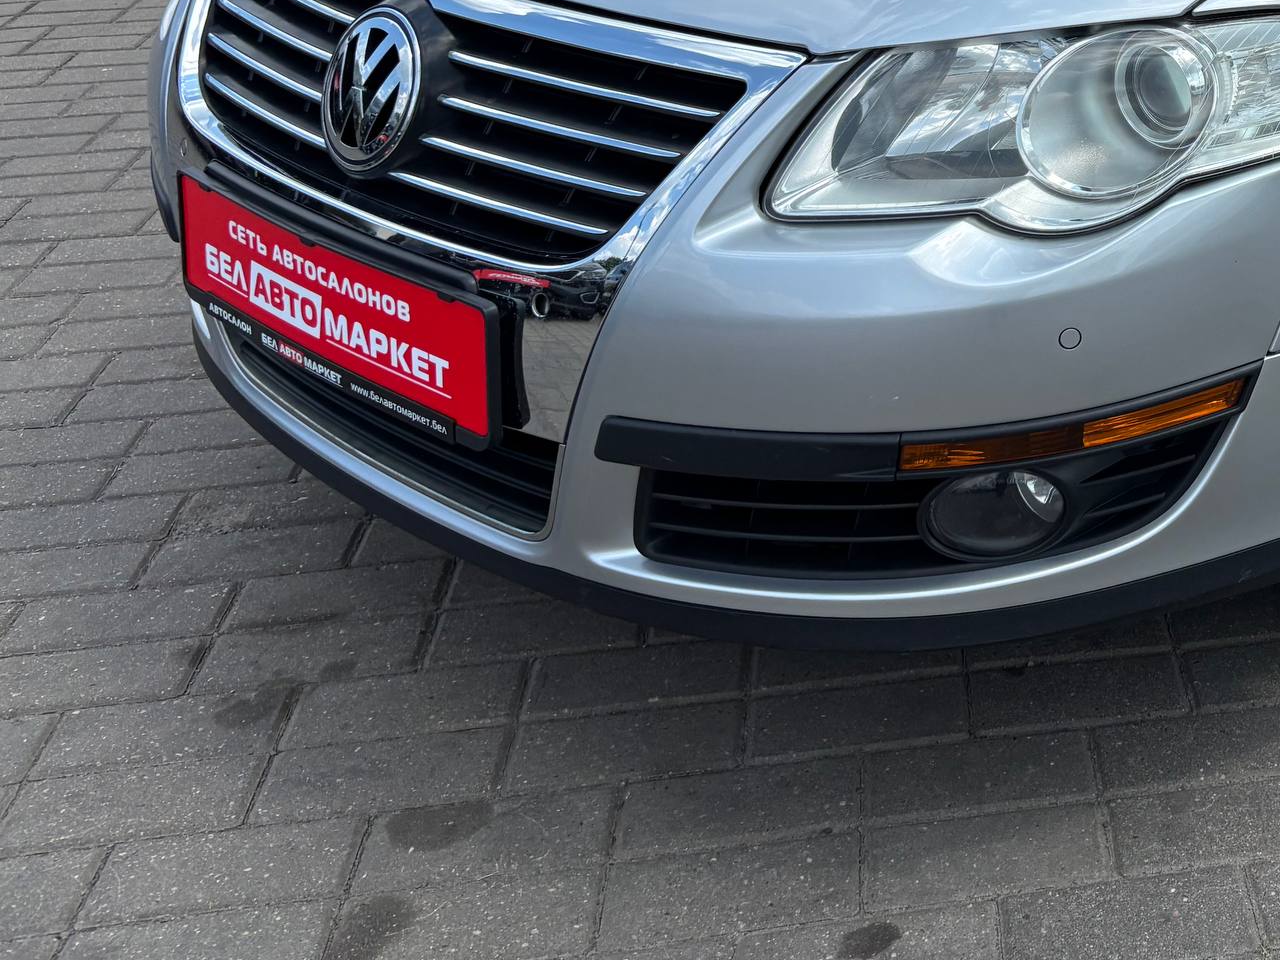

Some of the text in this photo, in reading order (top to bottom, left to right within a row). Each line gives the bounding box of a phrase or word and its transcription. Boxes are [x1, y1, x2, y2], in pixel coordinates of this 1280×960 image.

[228, 220, 411, 323] СЕТЬ АВТОСАЛОНОВ
[209, 302, 252, 335] АВТОСАЛОН
[350, 382, 448, 435] www.белавтомаркет.бел
